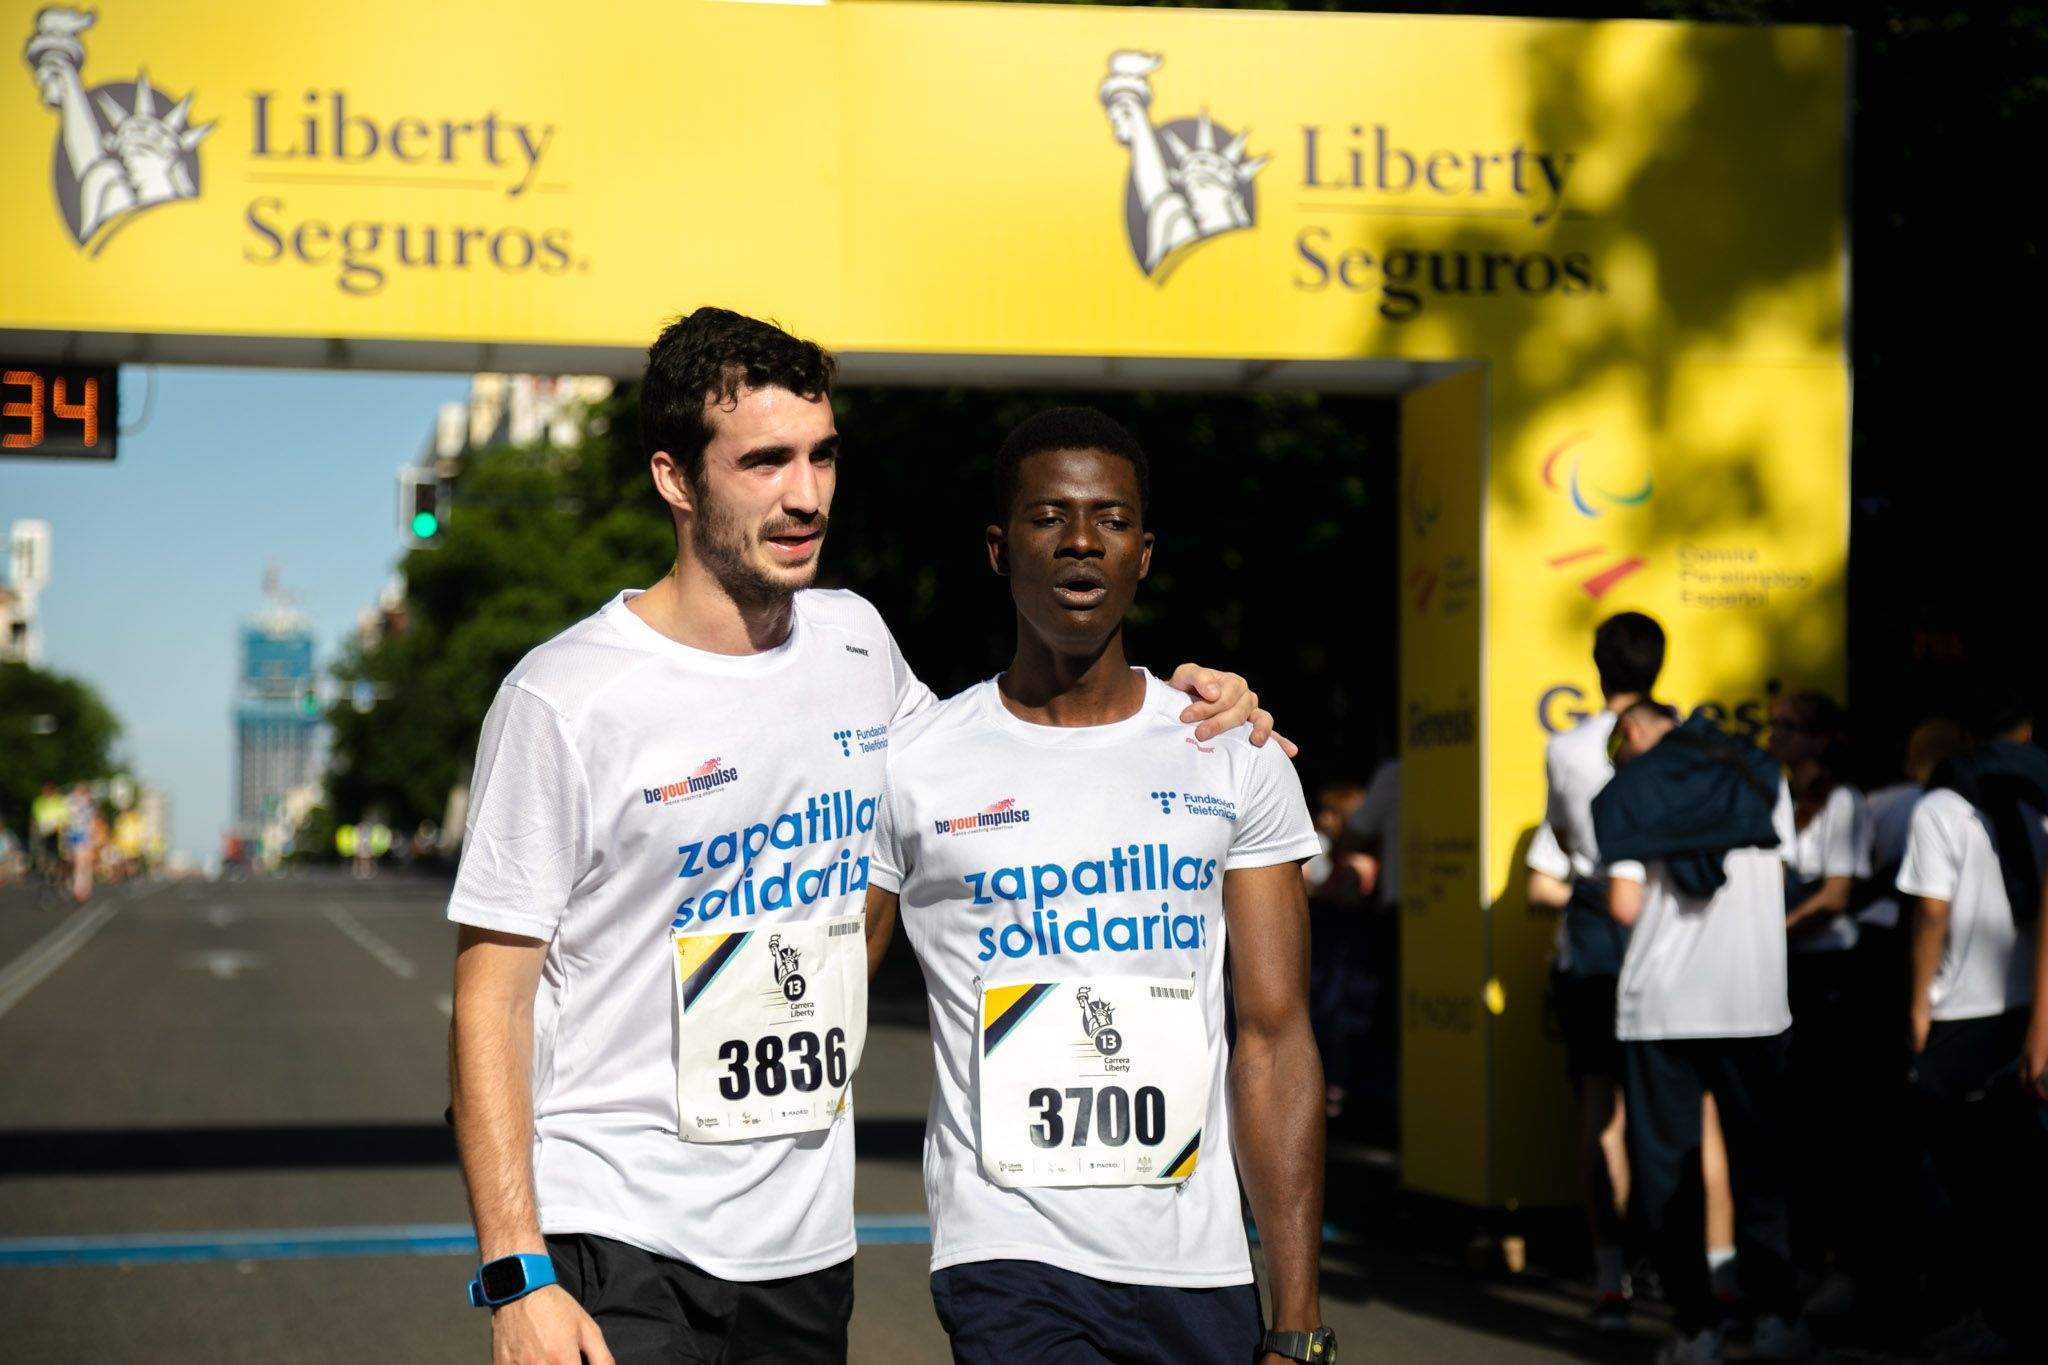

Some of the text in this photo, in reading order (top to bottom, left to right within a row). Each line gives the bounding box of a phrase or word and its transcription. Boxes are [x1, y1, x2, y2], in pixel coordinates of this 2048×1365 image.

[246, 91, 555, 195] Liberty
[1299, 124, 1574, 224] Liberty
[2, 370, 98, 448] 34
[643, 766, 738, 804] beyourimpulse
[1183, 793, 1236, 810] Fundación
[934, 809, 1030, 835] beyourimpulse
[1185, 804, 1237, 821] Telefónica
[677, 788, 883, 878] zapatilla
[671, 848, 870, 928] solidaria
[964, 843, 1217, 910] zapatillas
[788, 979, 803, 996] 13
[790, 1001, 815, 1010] Carrera
[790, 1008, 815, 1018] Liberty
[1100, 1034, 1117, 1050] 13
[718, 1027, 847, 1101] 3836
[1104, 1064, 1130, 1073] Liberty
[1028, 1085, 1166, 1149] 3700
